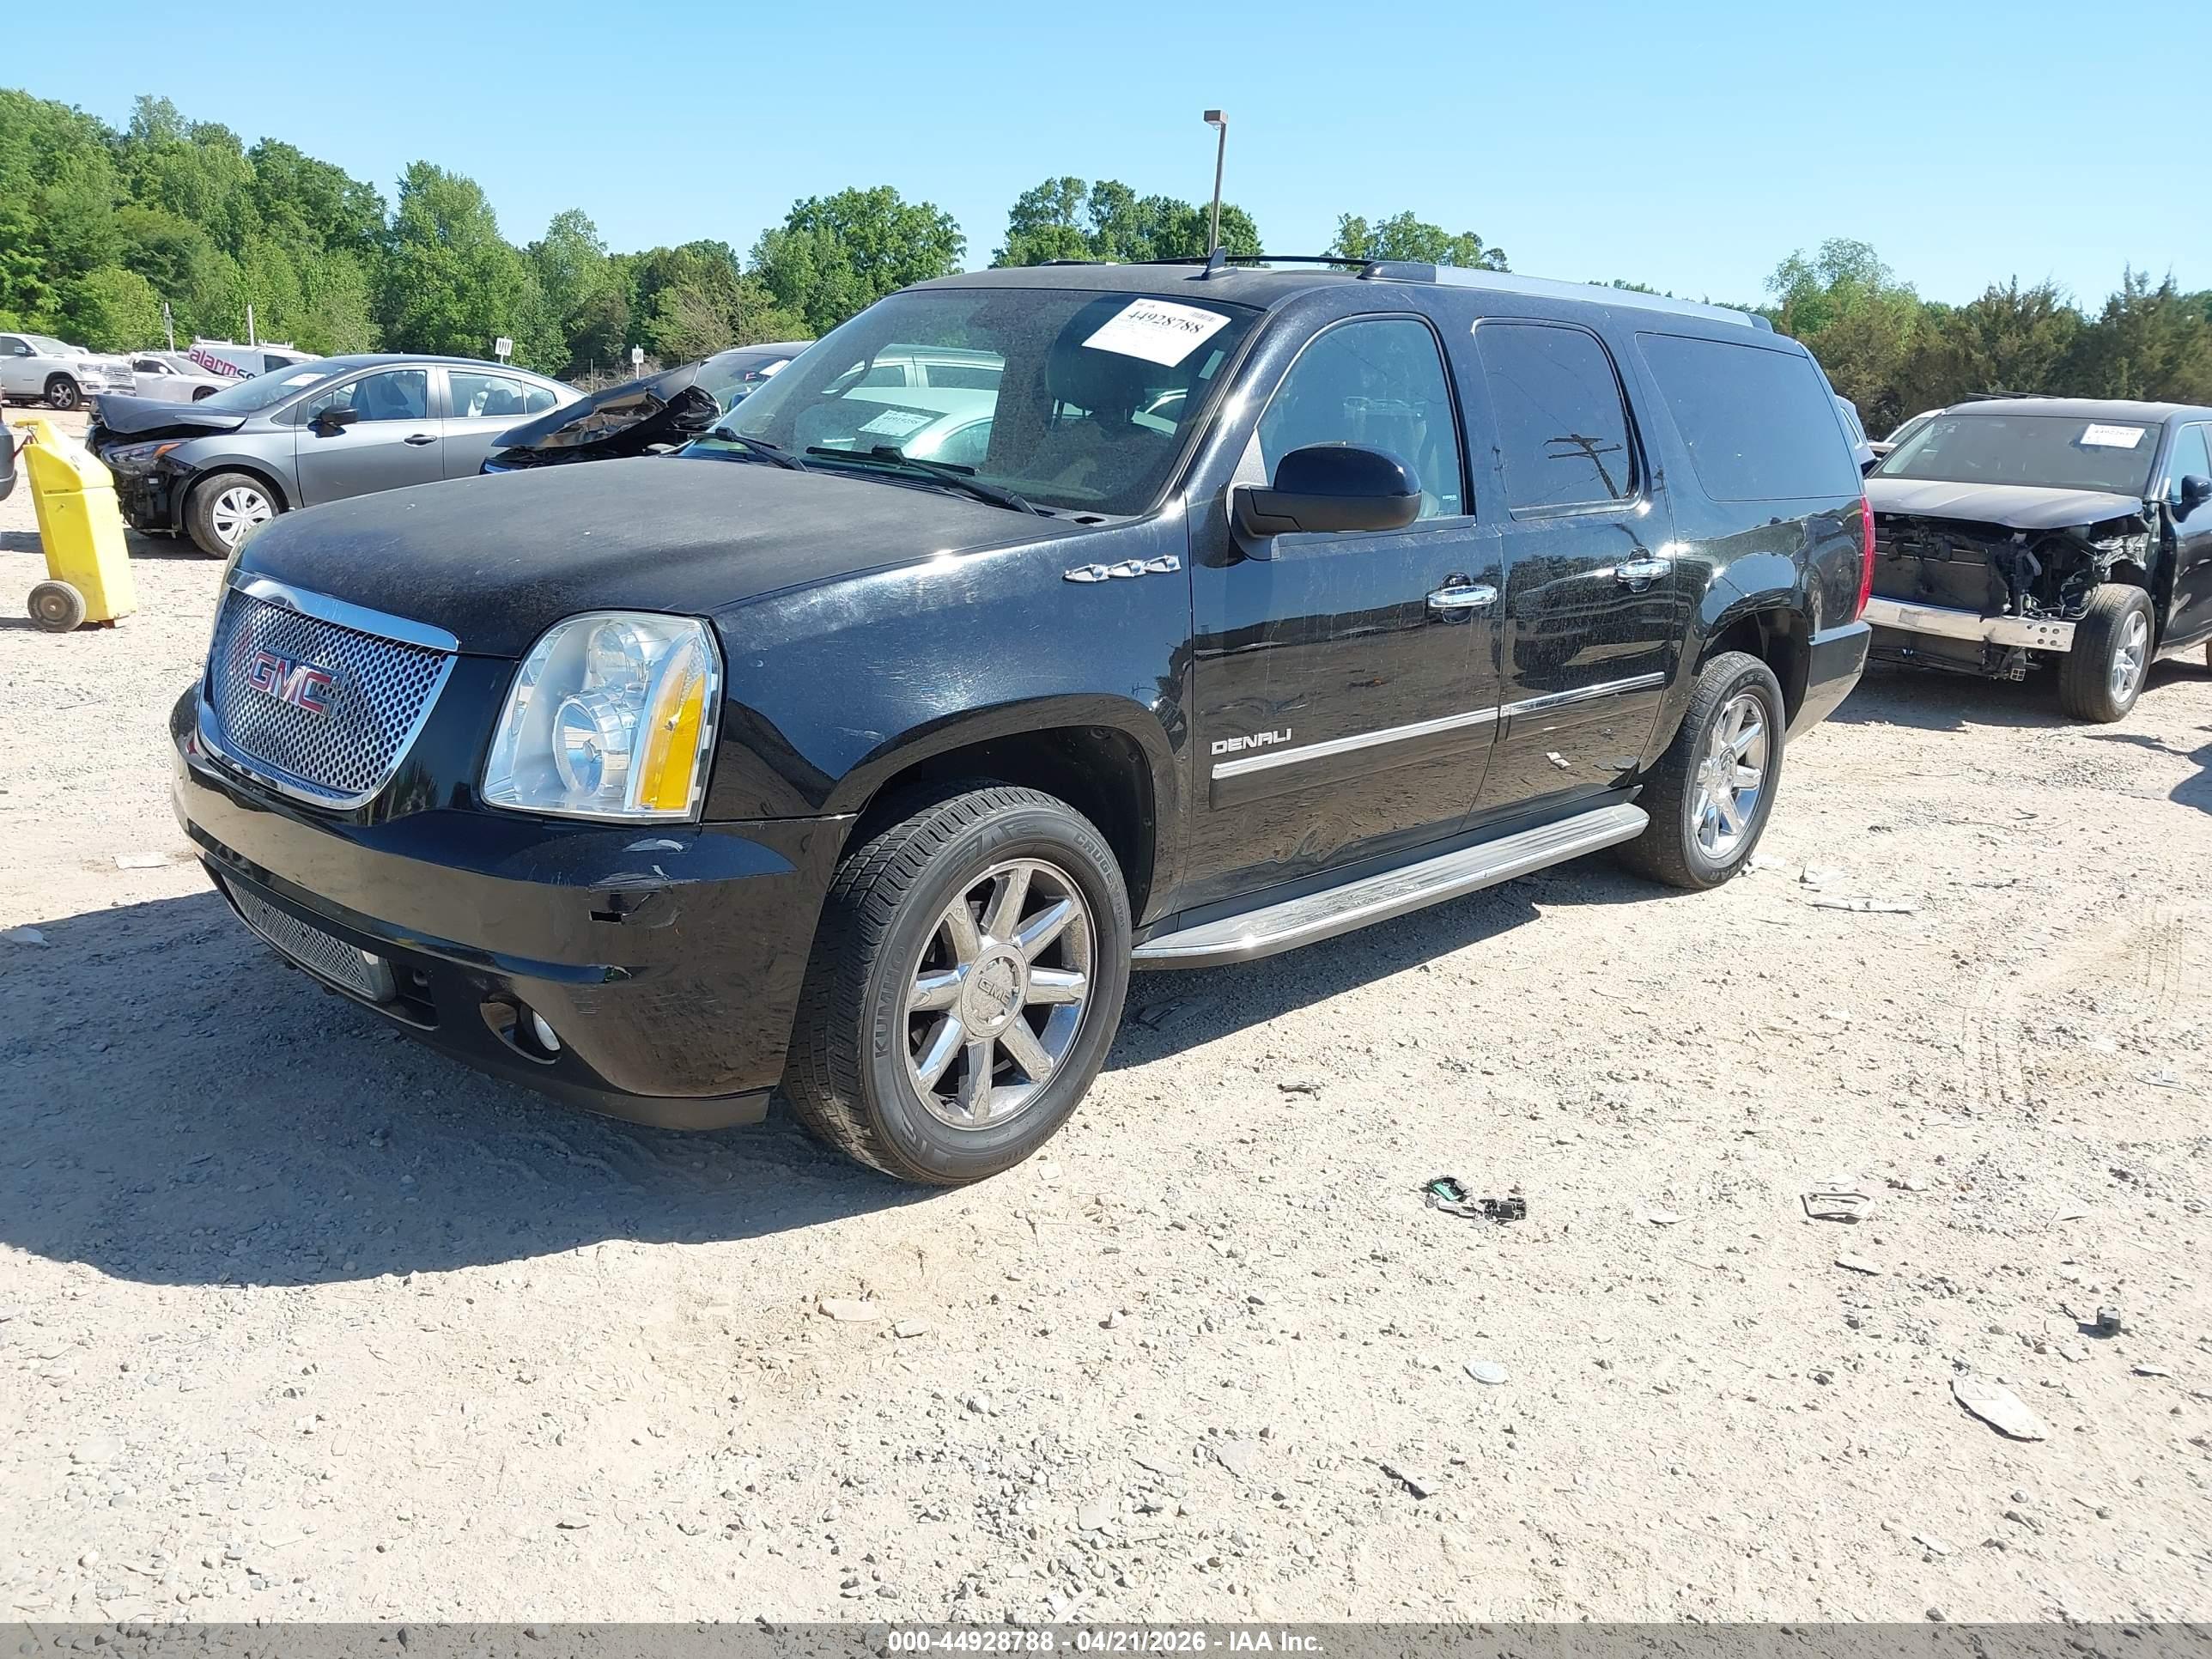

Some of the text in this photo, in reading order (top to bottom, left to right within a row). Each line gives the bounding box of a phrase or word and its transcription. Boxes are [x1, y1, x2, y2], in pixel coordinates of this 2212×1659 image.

[1127, 310, 1205, 334] 44928788
[248, 649, 335, 715] GMC
[1211, 727, 1292, 756] DENALI
[875, 945, 906, 1059] KUMHO
[977, 976, 1014, 1007] GMC
